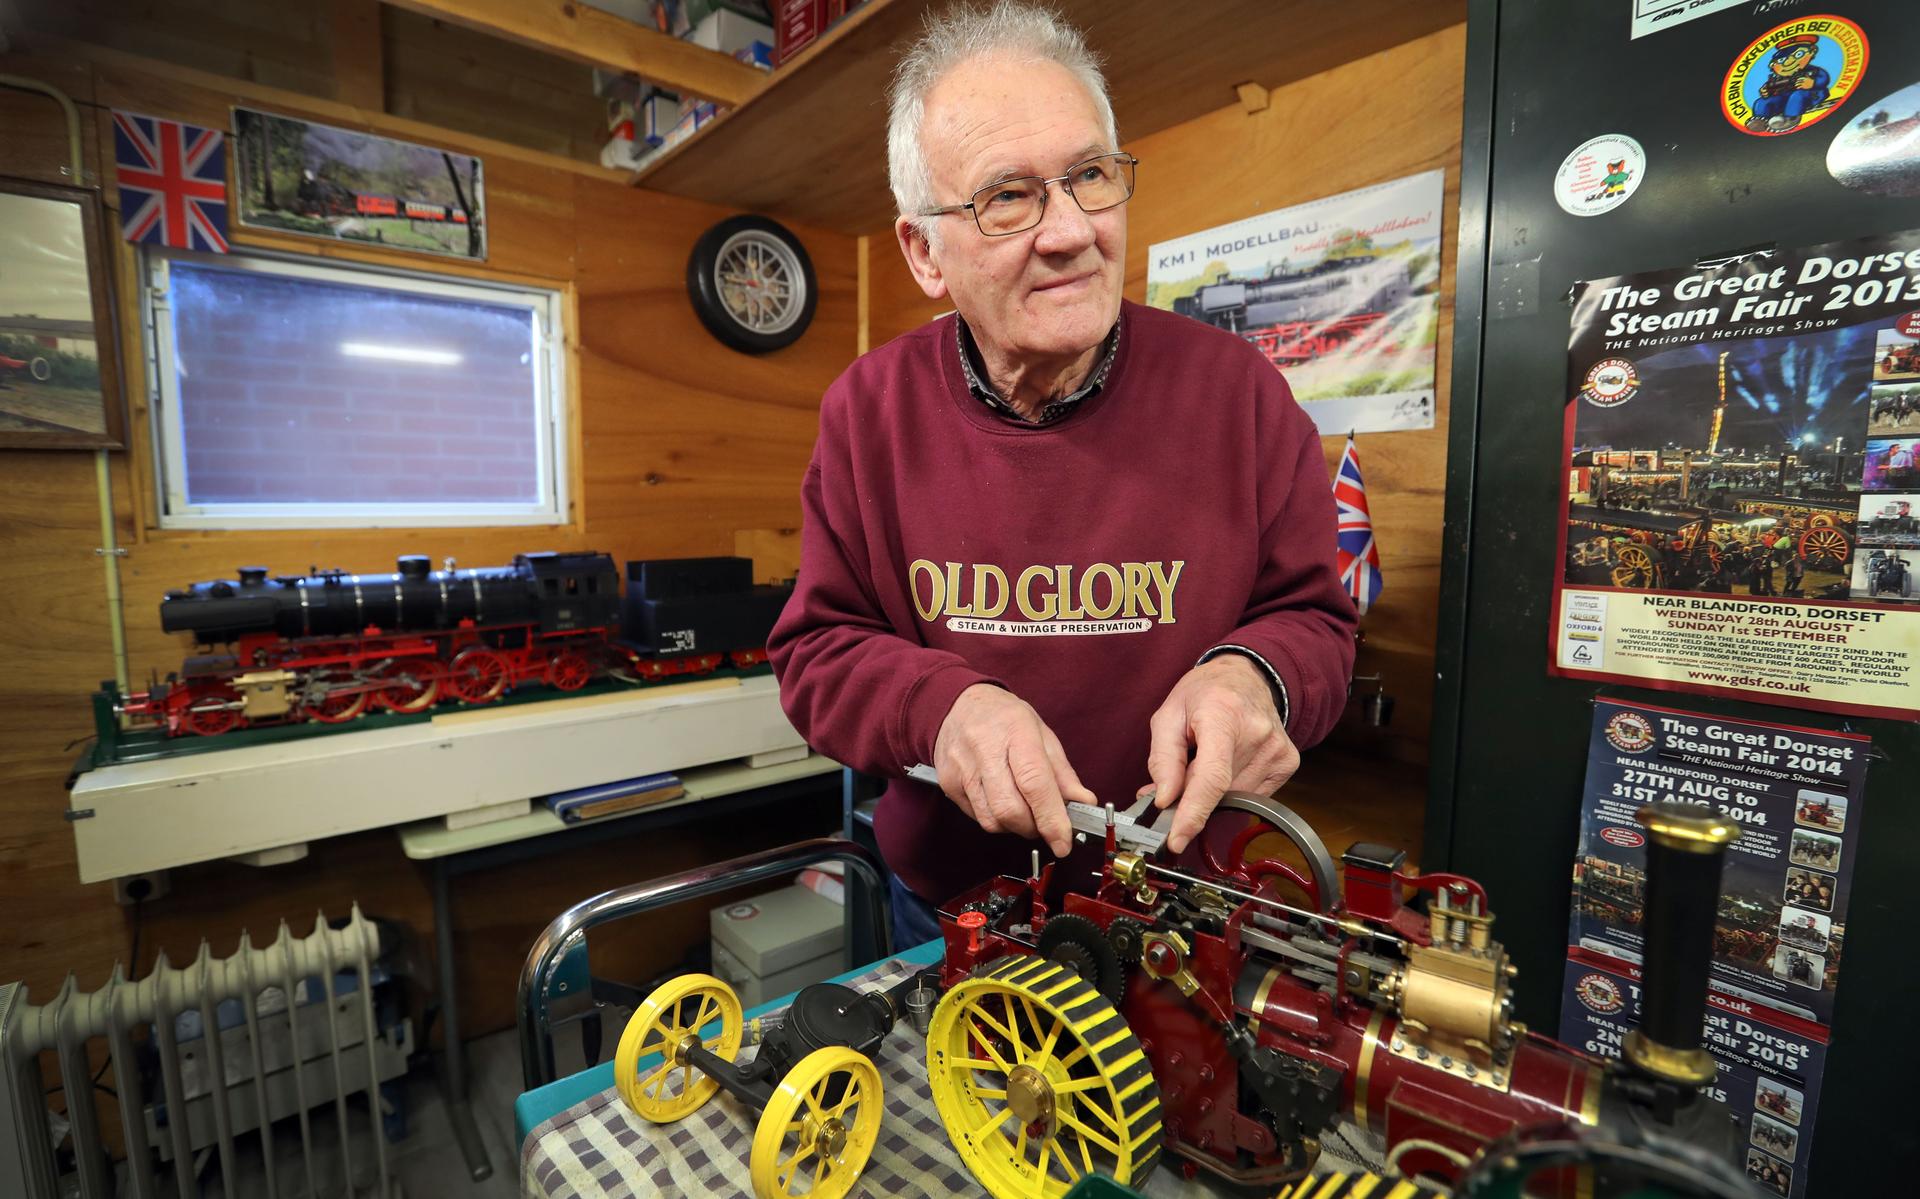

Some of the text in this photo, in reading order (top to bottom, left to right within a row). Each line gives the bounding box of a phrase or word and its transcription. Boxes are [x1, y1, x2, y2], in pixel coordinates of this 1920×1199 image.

[1728, 21, 1860, 119] ICH BIN LOKFÜHRER BEI FLEISCHMANN
[1600, 286, 1661, 311] The
[1673, 266, 1788, 301] Great
[1605, 275, 1920, 337] Steam Fair 2013
[1605, 318, 1839, 350] THE National Heritage Show
[1588, 360, 1608, 382] GREAT
[909, 559, 1184, 624] OLD GLORY
[1643, 597, 1885, 622] NEAR BLANDFORD, DORSET
[1655, 609, 1744, 624] WEDNESDAY
[1748, 616, 1779, 627] 28th
[1783, 620, 1854, 632] AUGUST
[957, 621, 1142, 633] STEAM & VINTAGE PRESERVATION
[1652, 629, 1702, 639] RECOGNISED
[1735, 638, 1774, 646] LEADING
[1668, 620, 1847, 644] SUNDAY 1st SEPTEMBER
[1617, 639, 1679, 649] SHOWGROUNDS
[1681, 644, 1723, 653] COVERING
[1740, 650, 1792, 660] INCREDIBLE
[1812, 658, 1845, 666] ACRES.
[1850, 662, 1910, 672] REGULARLY
[1622, 645, 1664, 653] ATTENDED
[1702, 652, 1729, 660] 200,000
[1731, 656, 1763, 664] PEOPLE
[1794, 662, 1836, 672] AROUND
[1862, 669, 1901, 677] WORLD
[1752, 646, 1795, 655] EUROPE'S
[1797, 650, 1840, 658] LARGEST
[1842, 655, 1895, 664] OUTDOOR
[1688, 671, 1811, 693] www.gdsf.co.uk
[1660, 718, 1854, 760] The Great Dorset
[1665, 734, 1731, 758] Steam
[1738, 746, 1779, 765] Fair
[1786, 755, 1844, 776] 2014
[1616, 757, 1770, 791] NEAR BLANDFORD, DORSET
[1681, 754, 1821, 784] THE National Heritage Show
[1623, 769, 1758, 806] 27TH AUG to
[1612, 783, 1658, 802] 31ST
[1718, 804, 1768, 826] 2014
[1586, 1015, 1616, 1030] NEAR
[1585, 1040, 1622, 1059] 6TH
[1702, 1025, 1799, 1071] Fair 2015
[1735, 1020, 1810, 1058] Dorset
[1708, 1044, 1779, 1075] Heritage Show
